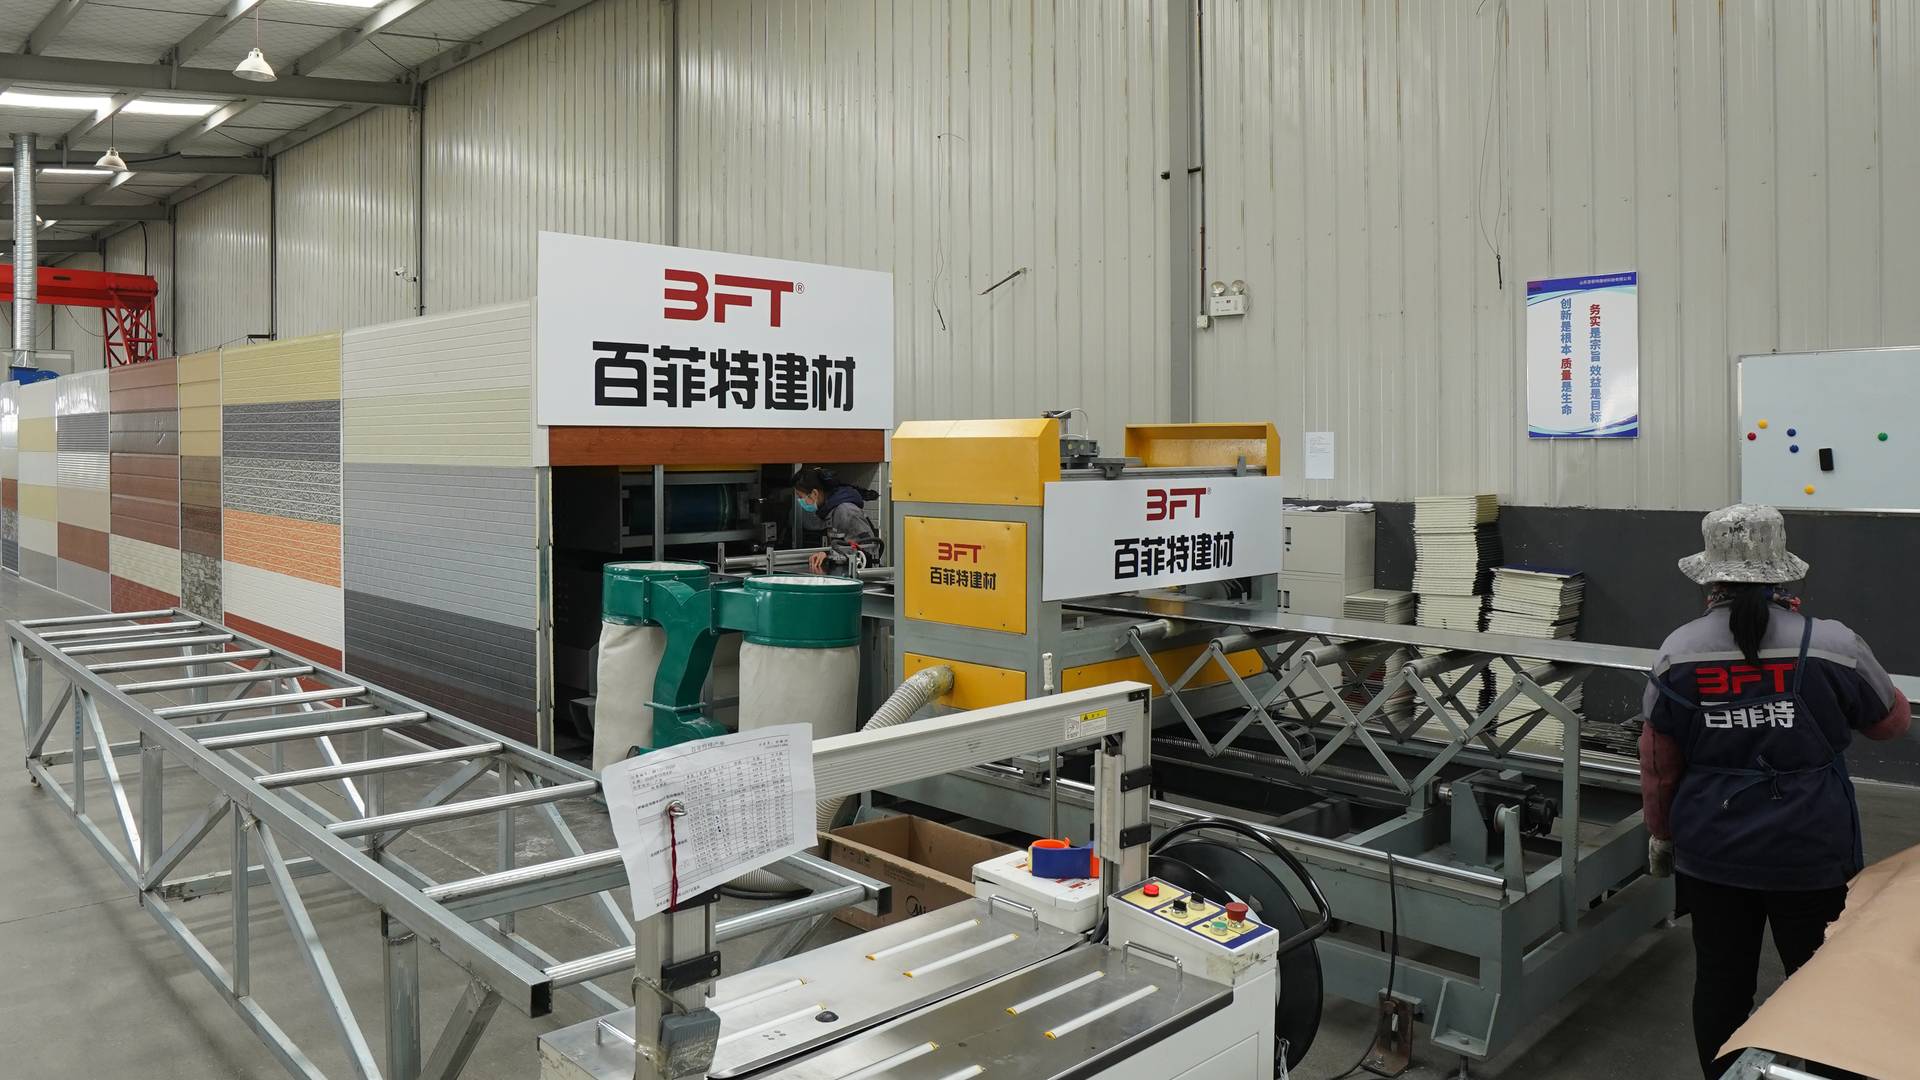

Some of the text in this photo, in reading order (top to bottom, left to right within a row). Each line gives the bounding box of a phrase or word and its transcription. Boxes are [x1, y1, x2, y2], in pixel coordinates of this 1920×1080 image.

[592, 340, 856, 412] 百菲特建材
[1560, 298, 1573, 416] 创新是根本 质量是生命
[1589, 304, 1602, 423] 务实是宗旨 效益是目标
[929, 566, 997, 591] 百菲特建材
[1113, 530, 1235, 580] 百菲特建材
[1700, 700, 1795, 729] 百菲特
